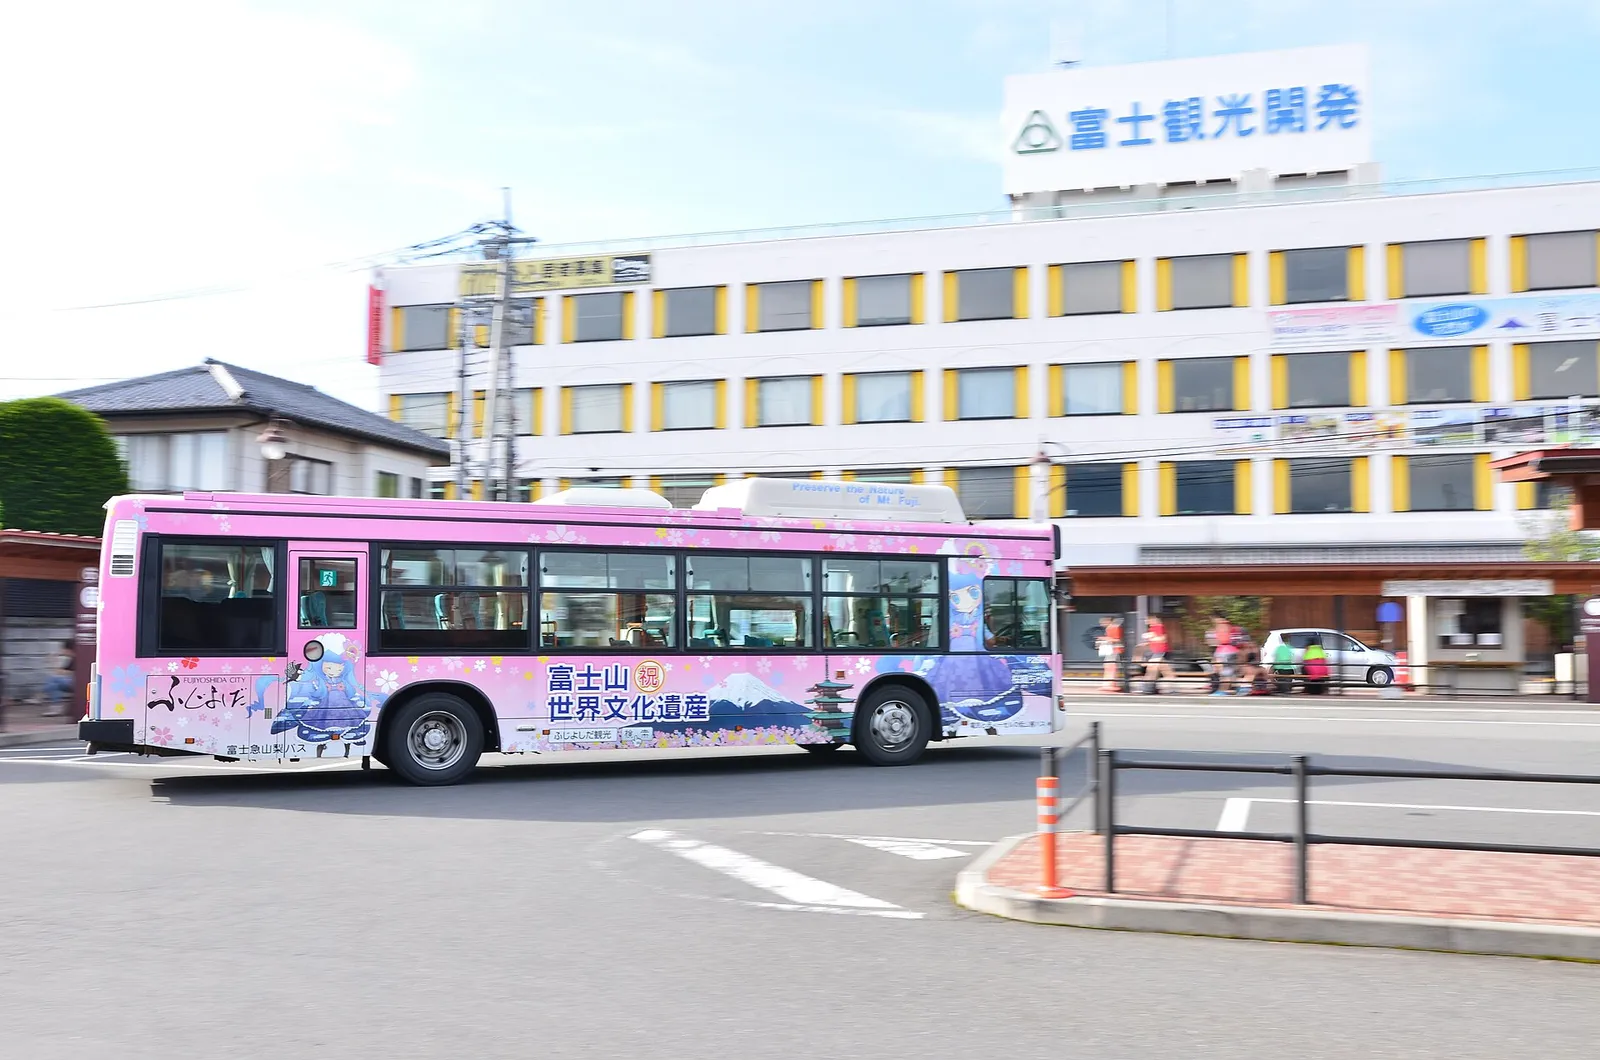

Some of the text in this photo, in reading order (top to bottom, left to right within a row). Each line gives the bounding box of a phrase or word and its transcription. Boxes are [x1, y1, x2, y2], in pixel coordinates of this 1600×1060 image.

[1068, 83, 1361, 151] 富士観光開発
[792, 483, 905, 496] Preserve the Nature
[859, 495, 870, 504] of
[549, 665, 628, 692] 富士山
[638, 666, 658, 687] 祝
[548, 694, 708, 722] 世界文化遺産
[553, 730, 612, 740] ふじよしだ観光
[226, 744, 307, 755] 富士急山梨バス
